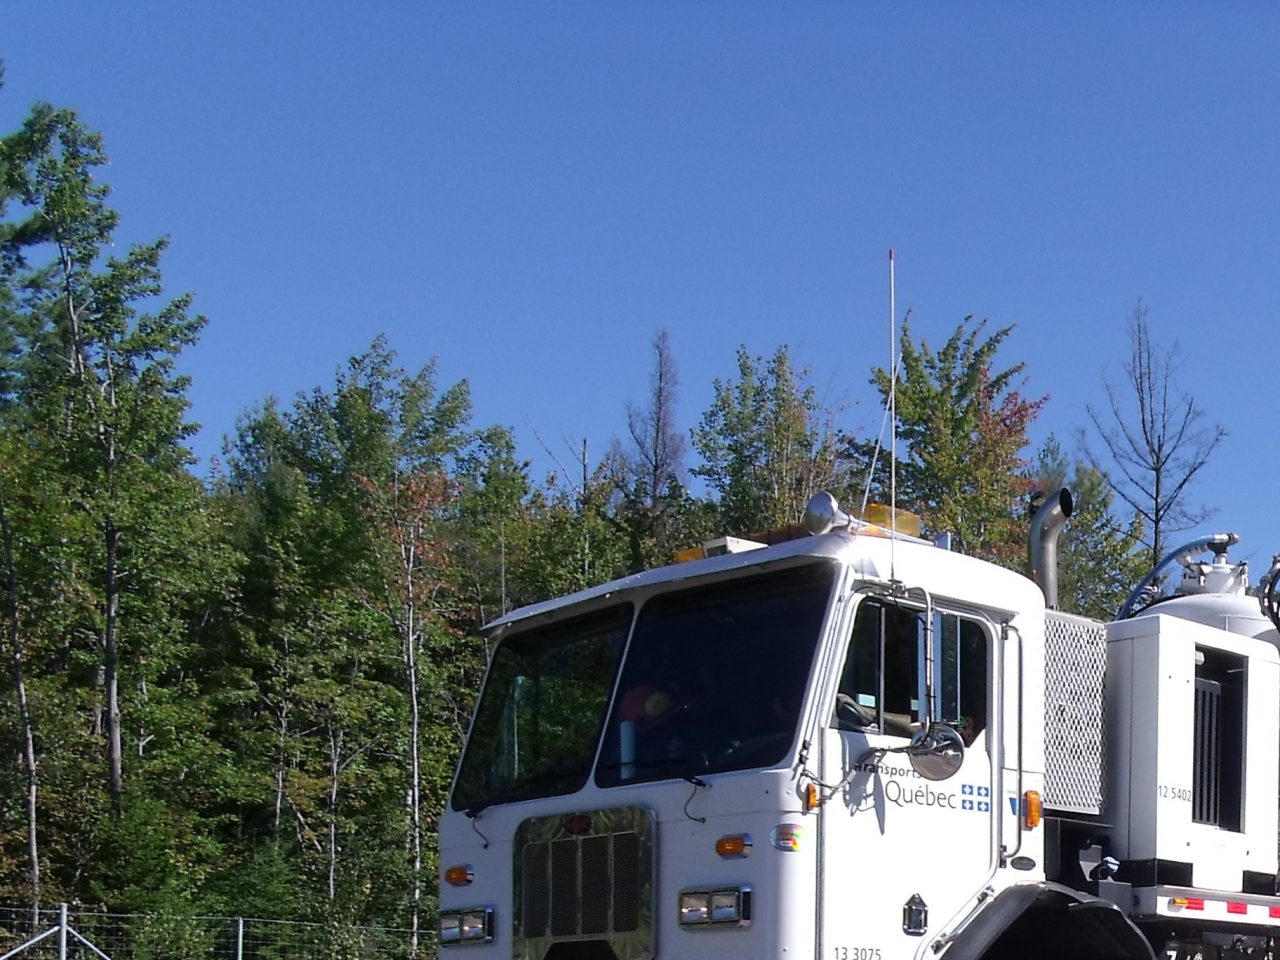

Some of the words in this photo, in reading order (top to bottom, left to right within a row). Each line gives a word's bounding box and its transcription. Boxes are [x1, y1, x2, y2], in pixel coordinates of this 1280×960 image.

[885, 780, 957, 808] Québec
[1159, 785, 1168, 798] 12
[1171, 787, 1191, 802] 5402
[834, 946, 848, 960] 13
